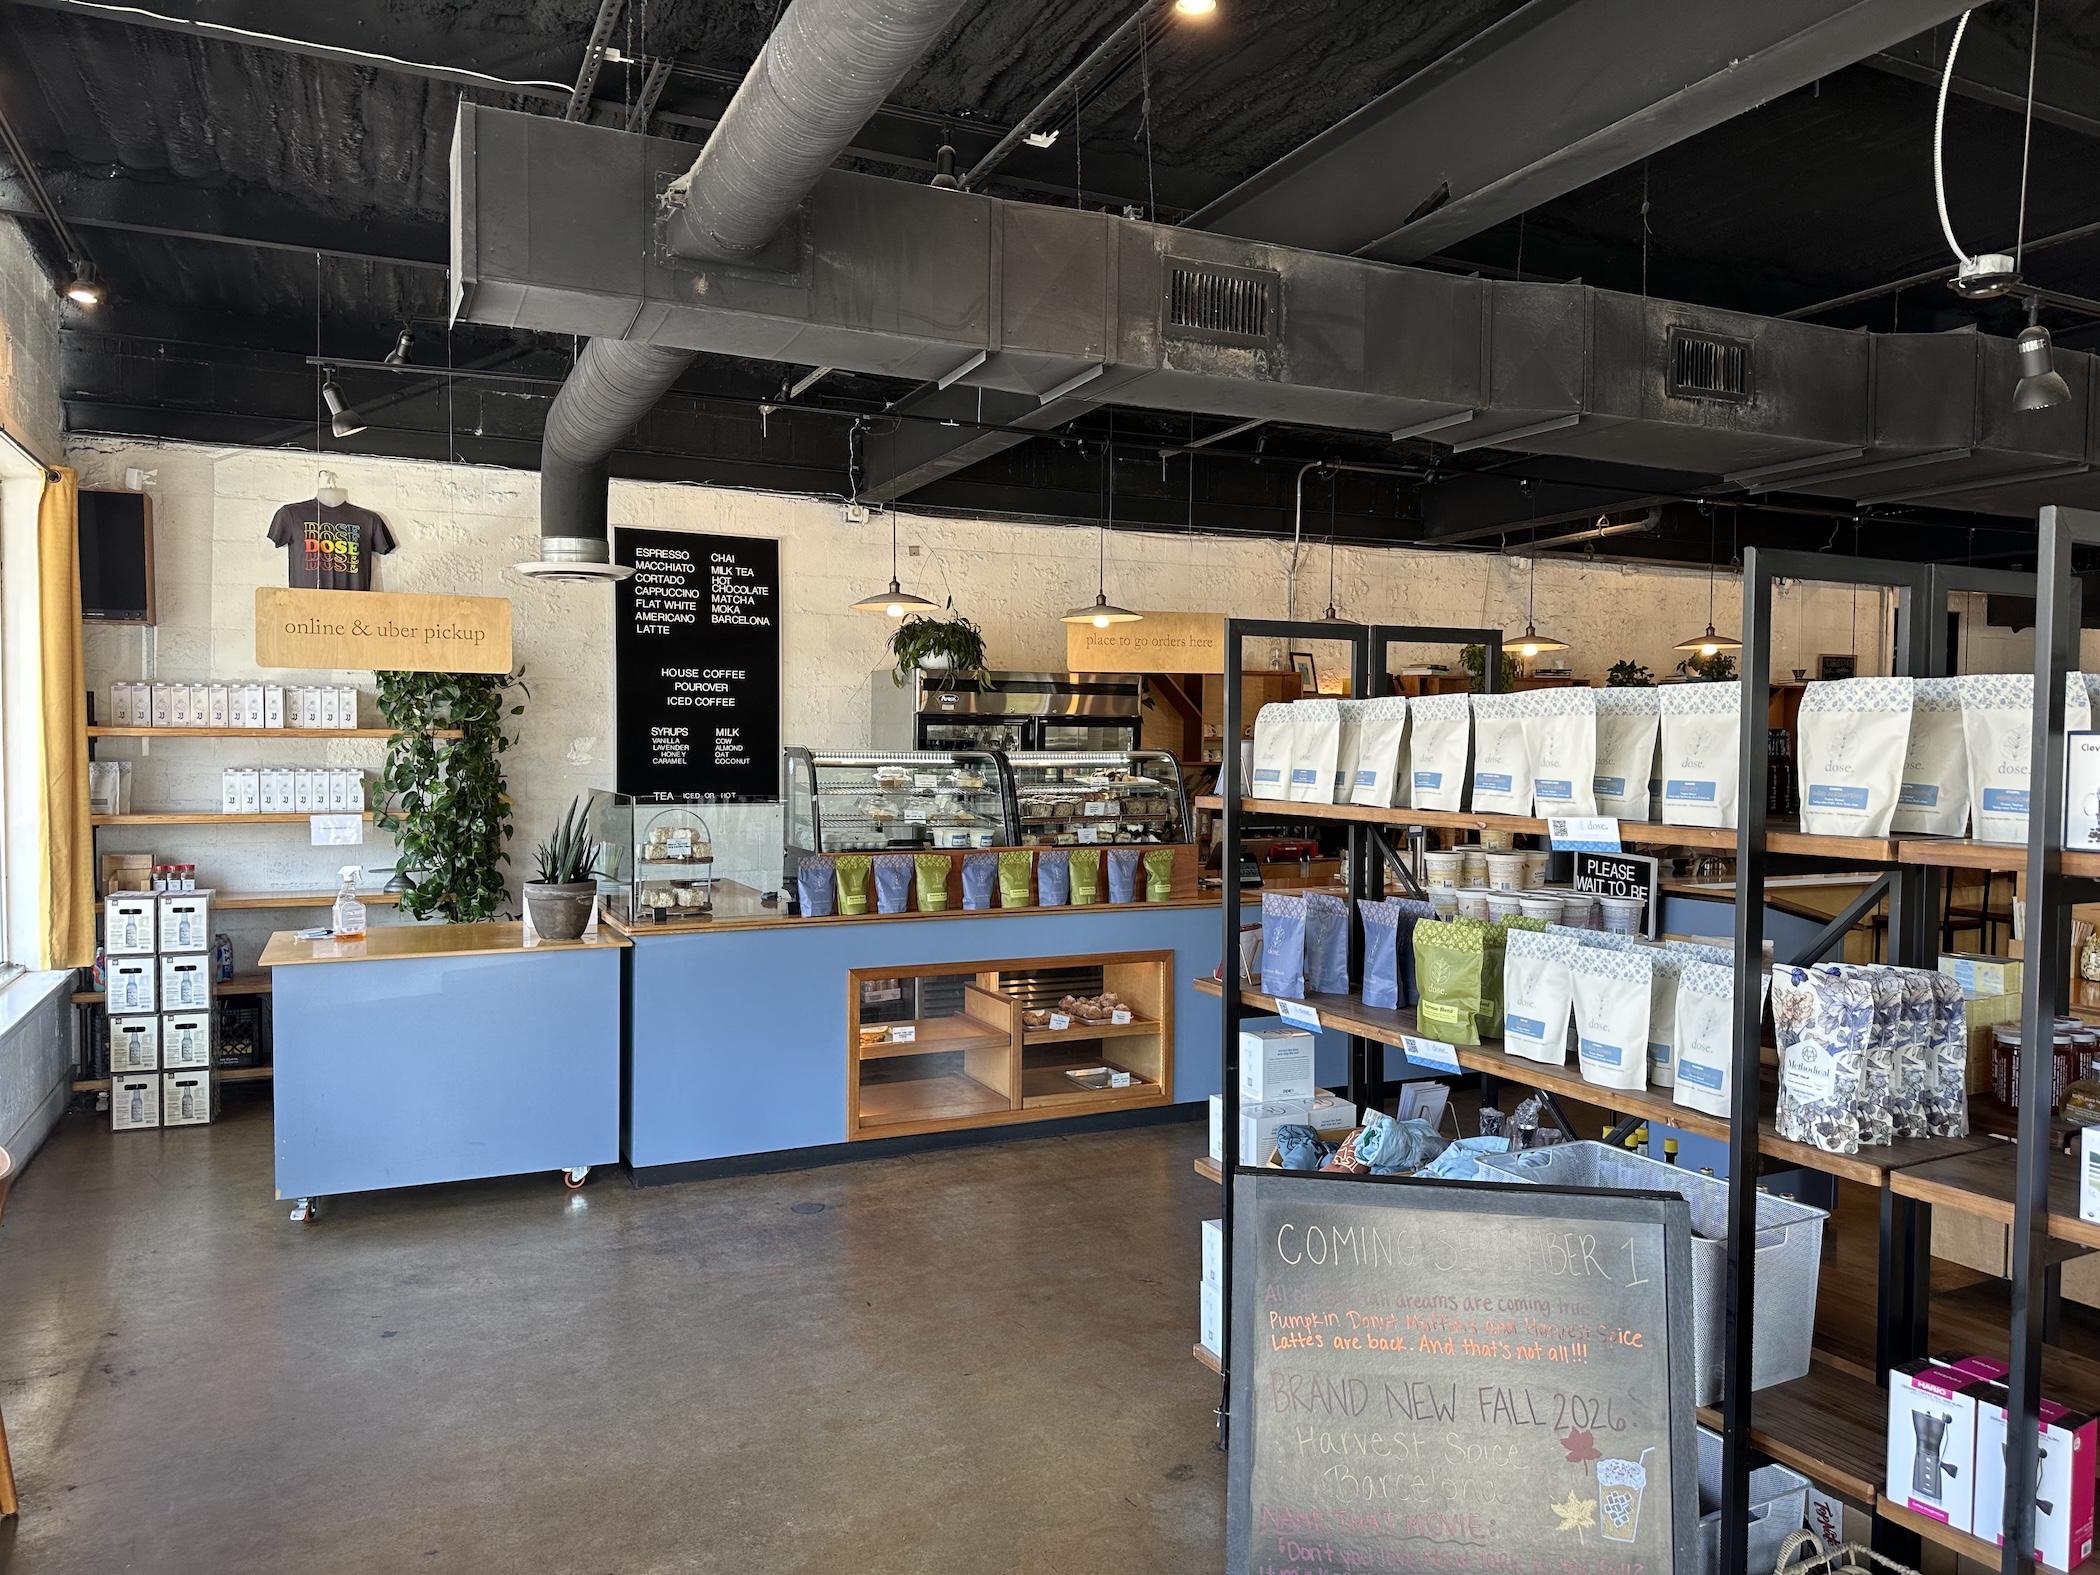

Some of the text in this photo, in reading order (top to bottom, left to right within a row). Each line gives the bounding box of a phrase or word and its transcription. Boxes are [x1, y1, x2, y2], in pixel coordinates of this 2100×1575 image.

[304, 539, 359, 556] DOSE
[636, 548, 690, 560] ESPRESSO
[711, 554, 735, 563] CHAI
[636, 560, 695, 573] MACCHIATO
[711, 566, 754, 577] MILK TEA
[635, 573, 685, 585] CORTADO
[712, 577, 732, 585] HOT
[635, 587, 699, 599] CAPPUCCINO
[712, 585, 769, 595] CHOCOLATE
[636, 599, 696, 611] FLAT WHITE
[712, 595, 755, 605] MATCHA
[712, 605, 740, 614] MOKA
[635, 611, 695, 624] AMERICANO
[712, 615, 770, 625] BARCELONA
[285, 618, 485, 645] online & uber pickup
[637, 625, 670, 635] LATTE
[1086, 633, 1213, 649] place to go orders here
[661, 668, 746, 679] HOUSE COFFEE
[675, 682, 728, 692] POUROVER
[667, 697, 735, 707] ICED COFFEE
[651, 727, 689, 736] SYRUPS
[716, 728, 739, 736] MILK
[1540, 755, 1562, 767] dose.
[1681, 756, 1705, 769] dose.
[1824, 759, 1855, 773] dose.
[1998, 761, 2031, 775] dose.
[653, 792, 674, 801] TEA
[1587, 820, 1609, 831] dose.
[1588, 859, 1635, 881] PLEASE
[1577, 875, 1648, 902] WAIT TO BE
[1427, 983, 1447, 996] dose.
[1589, 1018, 1611, 1032] dose.
[1691, 1038, 1713, 1054] dose.
[1787, 1059, 1830, 1077] Methodical
[1278, 1224, 1414, 1267] COMING
[1621, 1237, 1649, 1288] 1
[1395, 1290, 1458, 1311] dreams
[1463, 1296, 1493, 1311] are
[1498, 1297, 1550, 1318] coming
[1269, 1310, 1341, 1334] Pumpkin
[1405, 1312, 1478, 1335] Muffins
[1485, 1319, 1517, 1335] and
[1525, 1317, 1591, 1341] Harvest
[1597, 1325, 1644, 1350] Spice
[1271, 1332, 1588, 1364] Lattes are back. And that's not all!!!
[1917, 1380, 1947, 1396] HARIO
[1270, 1372, 1369, 1417] BRAND
[1384, 1381, 1457, 1423] NEW
[1479, 1386, 1546, 1426] FALL
[1296, 1426, 1425, 1461] Harvest
[1261, 1505, 1328, 1532] NAME
[1332, 1510, 1394, 1533] THAT
